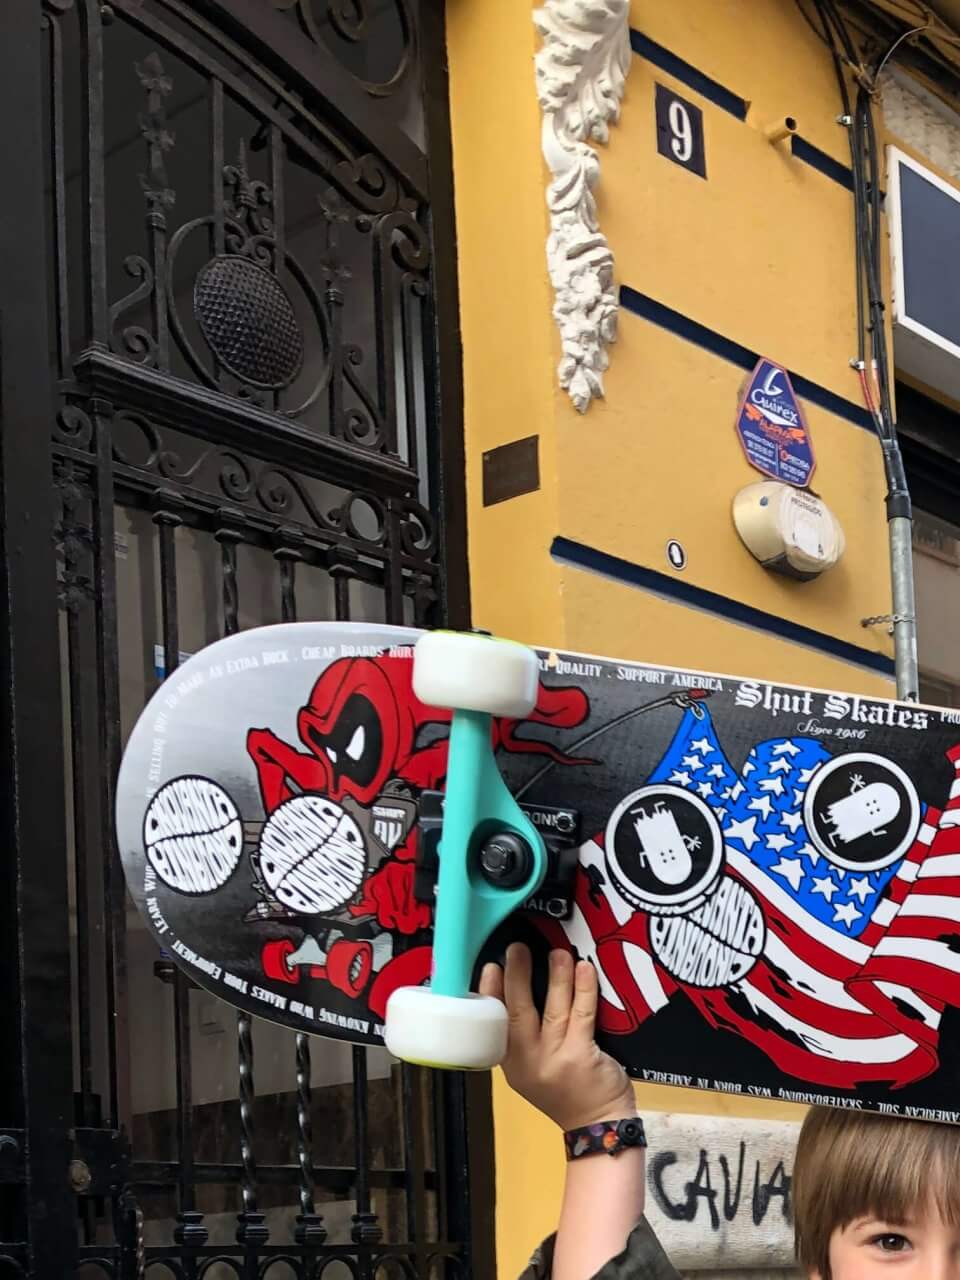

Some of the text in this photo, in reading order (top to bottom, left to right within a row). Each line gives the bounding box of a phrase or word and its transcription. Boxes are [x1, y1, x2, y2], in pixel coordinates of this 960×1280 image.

[669, 100, 692, 161] 9
[226, 655, 259, 676] EXTRA
[263, 650, 289, 667] BUCK
[302, 645, 336, 660] CHEAP
[555, 658, 602, 677] QUALITY
[617, 666, 724, 691] SUPPORT AMERICA
[734, 680, 929, 730] Shut Skates
[796, 718, 869, 740] Since 1986
[145, 897, 168, 934] LEARN
[171, 939, 221, 981] EQUIPMENT
[223, 972, 249, 995] YOUR
[250, 987, 287, 1010] MAKES
[290, 1000, 315, 1020] WHO
[319, 1008, 370, 1034] KNOWING
[642, 1069, 863, 1110] SKATEBOARDING WAS BORN IN AMERICA
[877, 1103, 900, 1115] SOIL
[905, 1106, 960, 1123] AMERICAN
